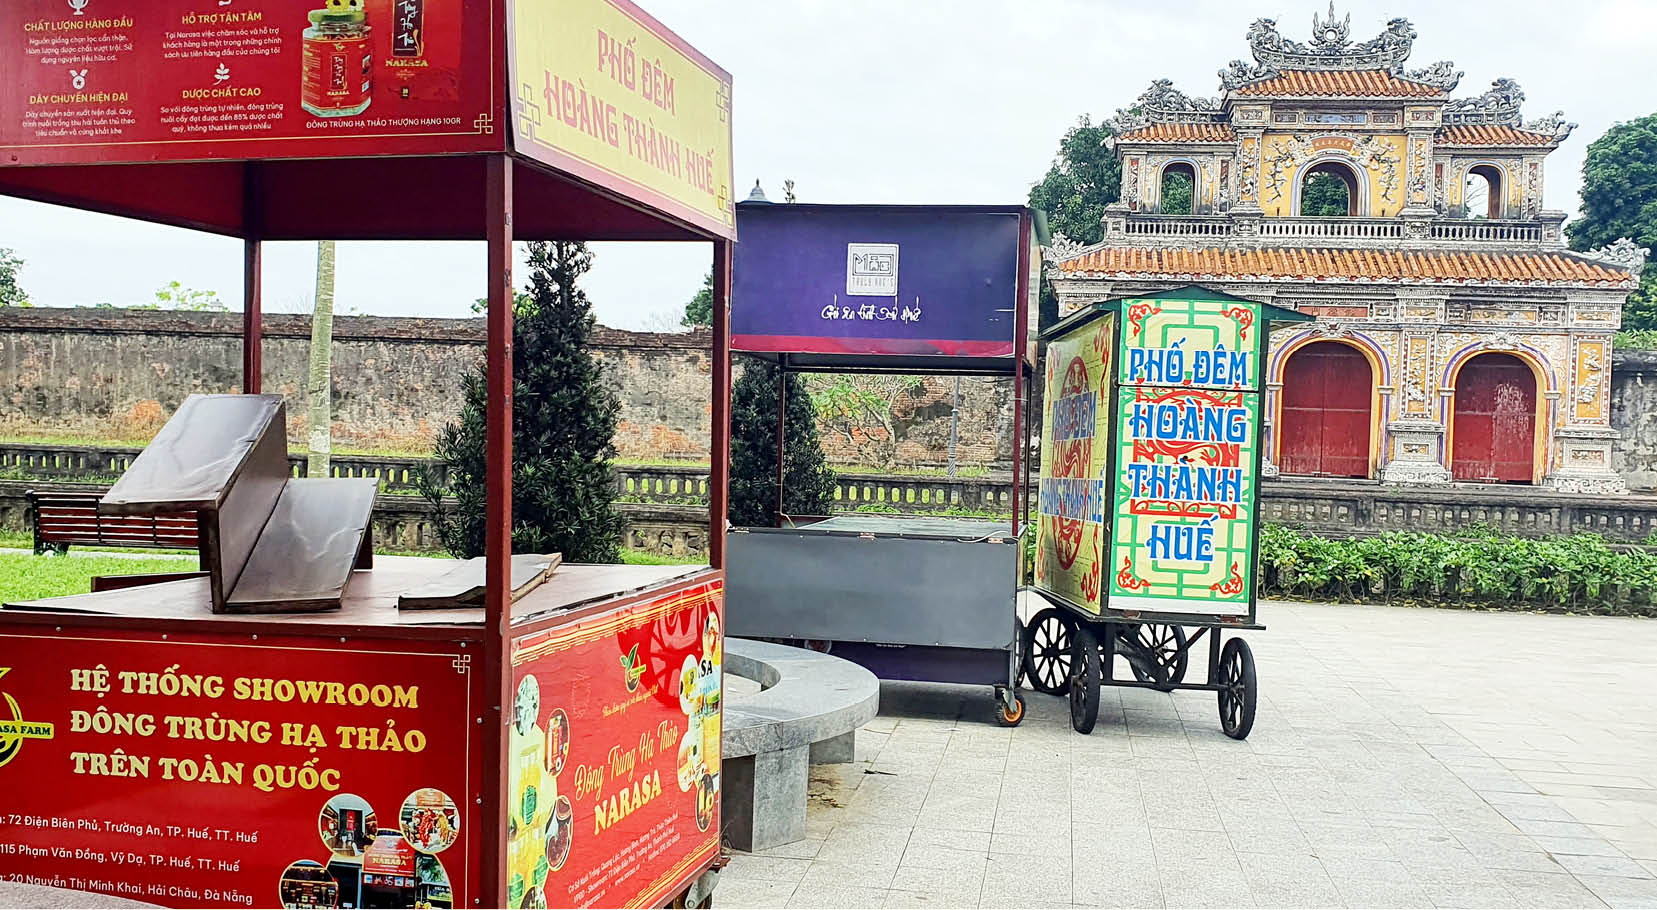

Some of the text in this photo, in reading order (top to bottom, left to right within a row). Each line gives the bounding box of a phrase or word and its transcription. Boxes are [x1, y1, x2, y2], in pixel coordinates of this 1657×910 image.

[24, 15, 134, 32] CHẤT LƯỢNG HÀNG ĐẦU
[182, 11, 262, 25] HỖ TRỢ TẬN TÂM
[182, 85, 262, 100] DƯỢC CHẤT CAO
[597, 29, 676, 117] PHỐ ĐÊM
[306, 117, 461, 128] ĐÔNG TRÙNG HẠ THẢO THƯỢNG HẠNG 10GR
[544, 70, 715, 196] HOÀNG THÀNH HUẾ
[1128, 337, 1249, 387] PHỐ ĐÊM
[1128, 397, 1247, 443] HOÀNG
[1127, 459, 1243, 503] THÀNH
[1146, 514, 1219, 562] HUẾ
[70, 663, 420, 709] HỆ THỐNG SHOWROOM
[20, 725, 51, 736] FARM
[70, 705, 427, 753] ĐÔNG TRÙNG HẠ THẢO
[70, 747, 341, 792] TRÊN TOÀN QUỐC
[574, 719, 678, 802] Đông Trùng Hạ Thảo
[594, 769, 663, 836] NARASA
[8, 814, 22, 825] 72
[24, 815, 49, 829] Điện
[51, 816, 75, 829] Biên
[77, 818, 101, 832] Phủ,
[104, 821, 143, 837] Trường
[146, 824, 164, 837] An,
[166, 825, 184, 838] TP.
[187, 826, 212, 841] Huế,
[214, 829, 233, 842] TT.
[236, 830, 258, 843] Huế
[18, 844, 48, 857] Phạm
[51, 846, 72, 858] Văn
[75, 847, 107, 863] Đồng,
[110, 851, 125, 864] Vỹ
[127, 852, 146, 866] Dạ,
[148, 854, 166, 867] TP.
[169, 855, 194, 870] Huế,
[197, 858, 215, 871] TT.
[218, 859, 240, 872] Huế
[89, 879, 114, 892] Minh
[117, 881, 144, 895] Khai,
[147, 883, 166, 896] Hải
[168, 886, 201, 900] Châu,
[204, 888, 220, 900] Đà
[222, 889, 253, 906] Nẵng
